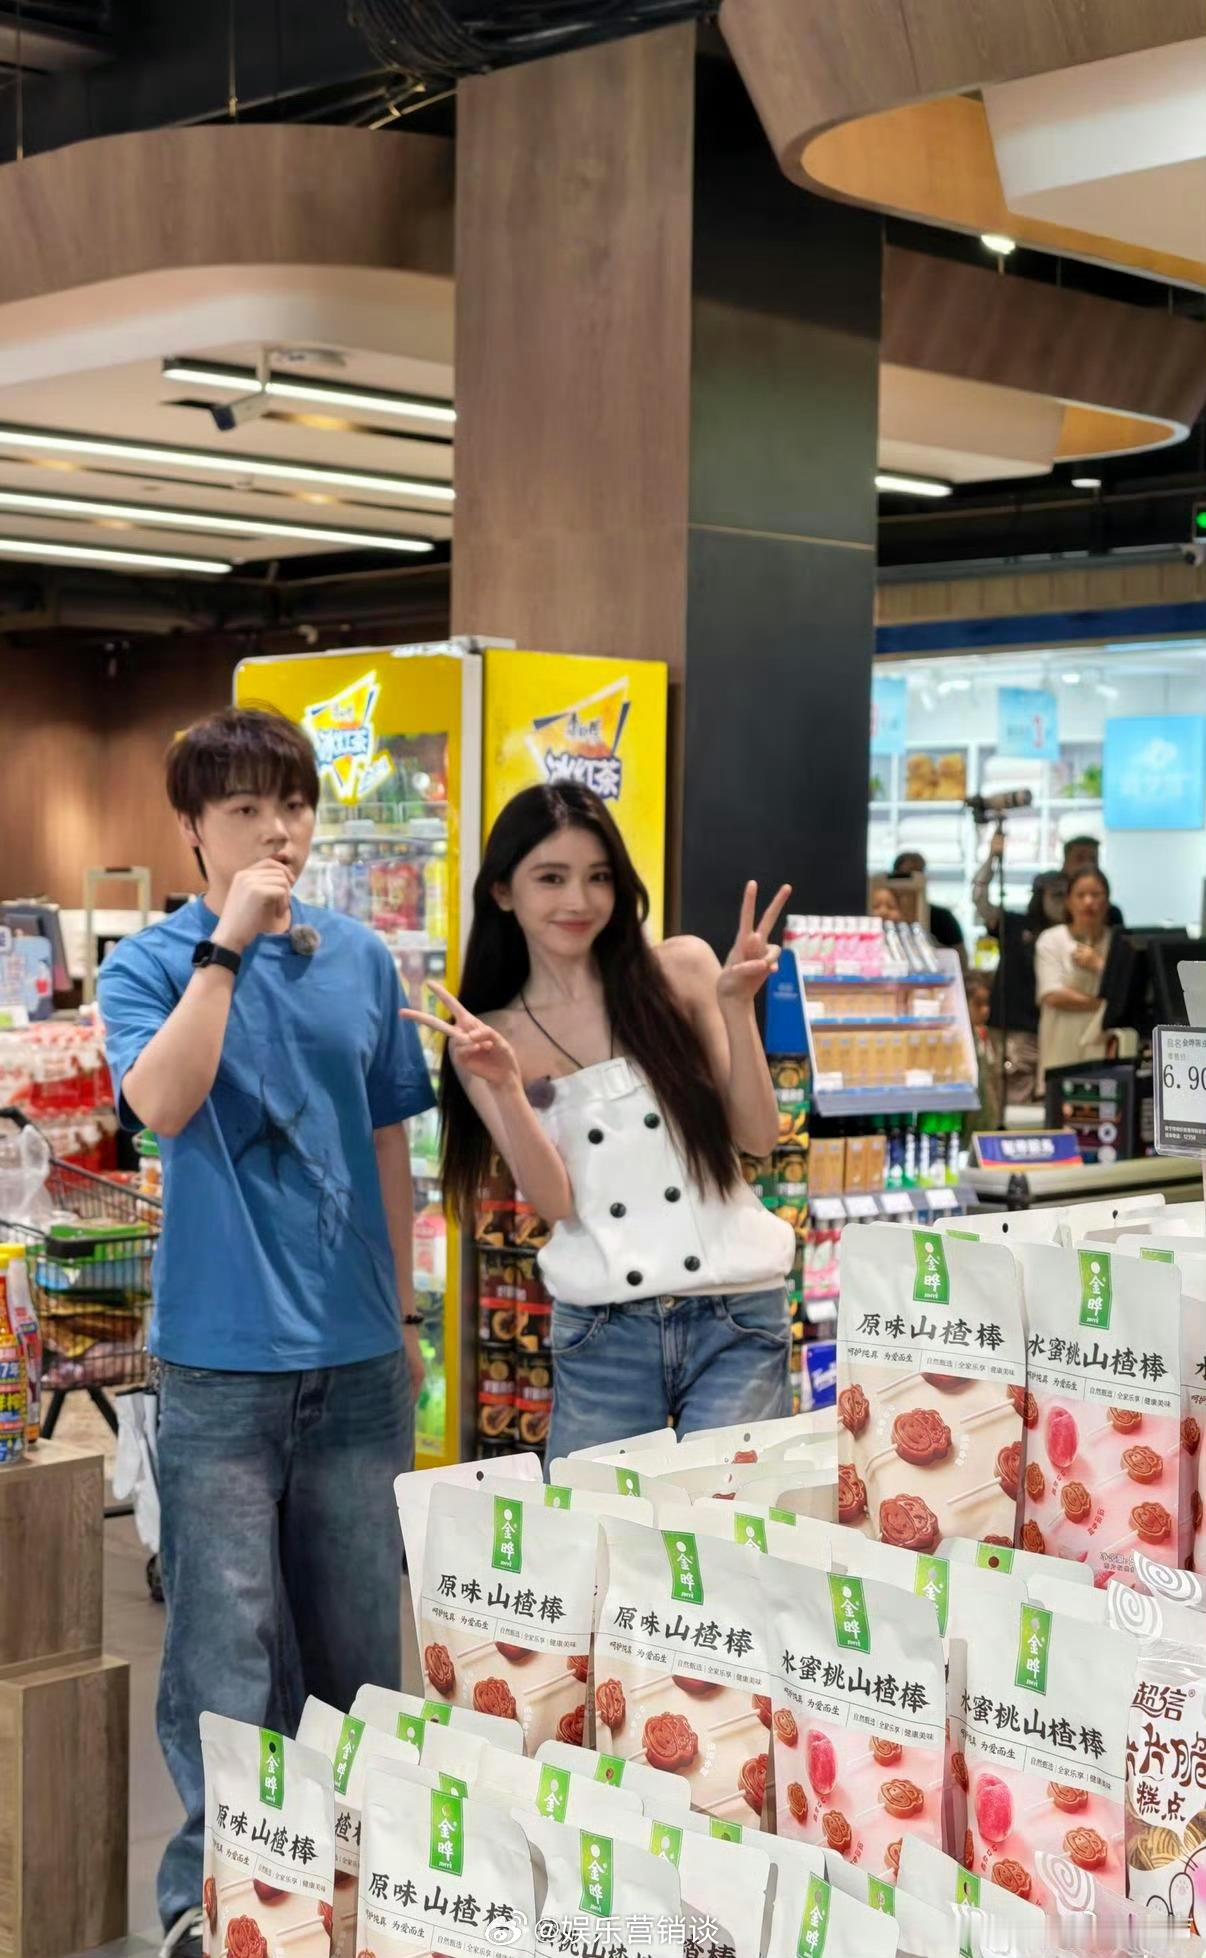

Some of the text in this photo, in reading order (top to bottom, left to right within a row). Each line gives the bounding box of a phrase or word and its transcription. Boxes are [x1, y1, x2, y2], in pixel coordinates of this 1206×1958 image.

[924, 1254, 942, 1292] 金晔
[1087, 1275, 1105, 1316] 金晔
[856, 1313, 1005, 1351] 原味山楂棒
[1027, 1333, 1168, 1382] 水蜜桃山楂棒
[501, 1521, 516, 1560] 金晔
[676, 1553, 695, 1591] 金晔
[437, 1573, 567, 1624] 原味山楂棒
[841, 1599, 861, 1639] 金晔
[460, 1615, 489, 1630] 为爱而生
[613, 1606, 754, 1658] 原味山楂棒
[1026, 1633, 1043, 1679] 金晔
[781, 1649, 931, 1714] 水蜜桃山楂棒
[1130, 1681, 1187, 1722] 超信
[807, 1698, 840, 1716] 为爱而生
[960, 1689, 1107, 1759] 水蜜桃山楂棒
[980, 1740, 1016, 1760] 为爱而生
[264, 1755, 279, 1796] 金晔
[1136, 1781, 1186, 1822] 糕点
[216, 1803, 319, 1865] 原味山楂棒
[437, 1818, 455, 1861] 金晔
[587, 1859, 605, 1904] 金晔
[392, 1919, 425, 1938] 为爱而生
